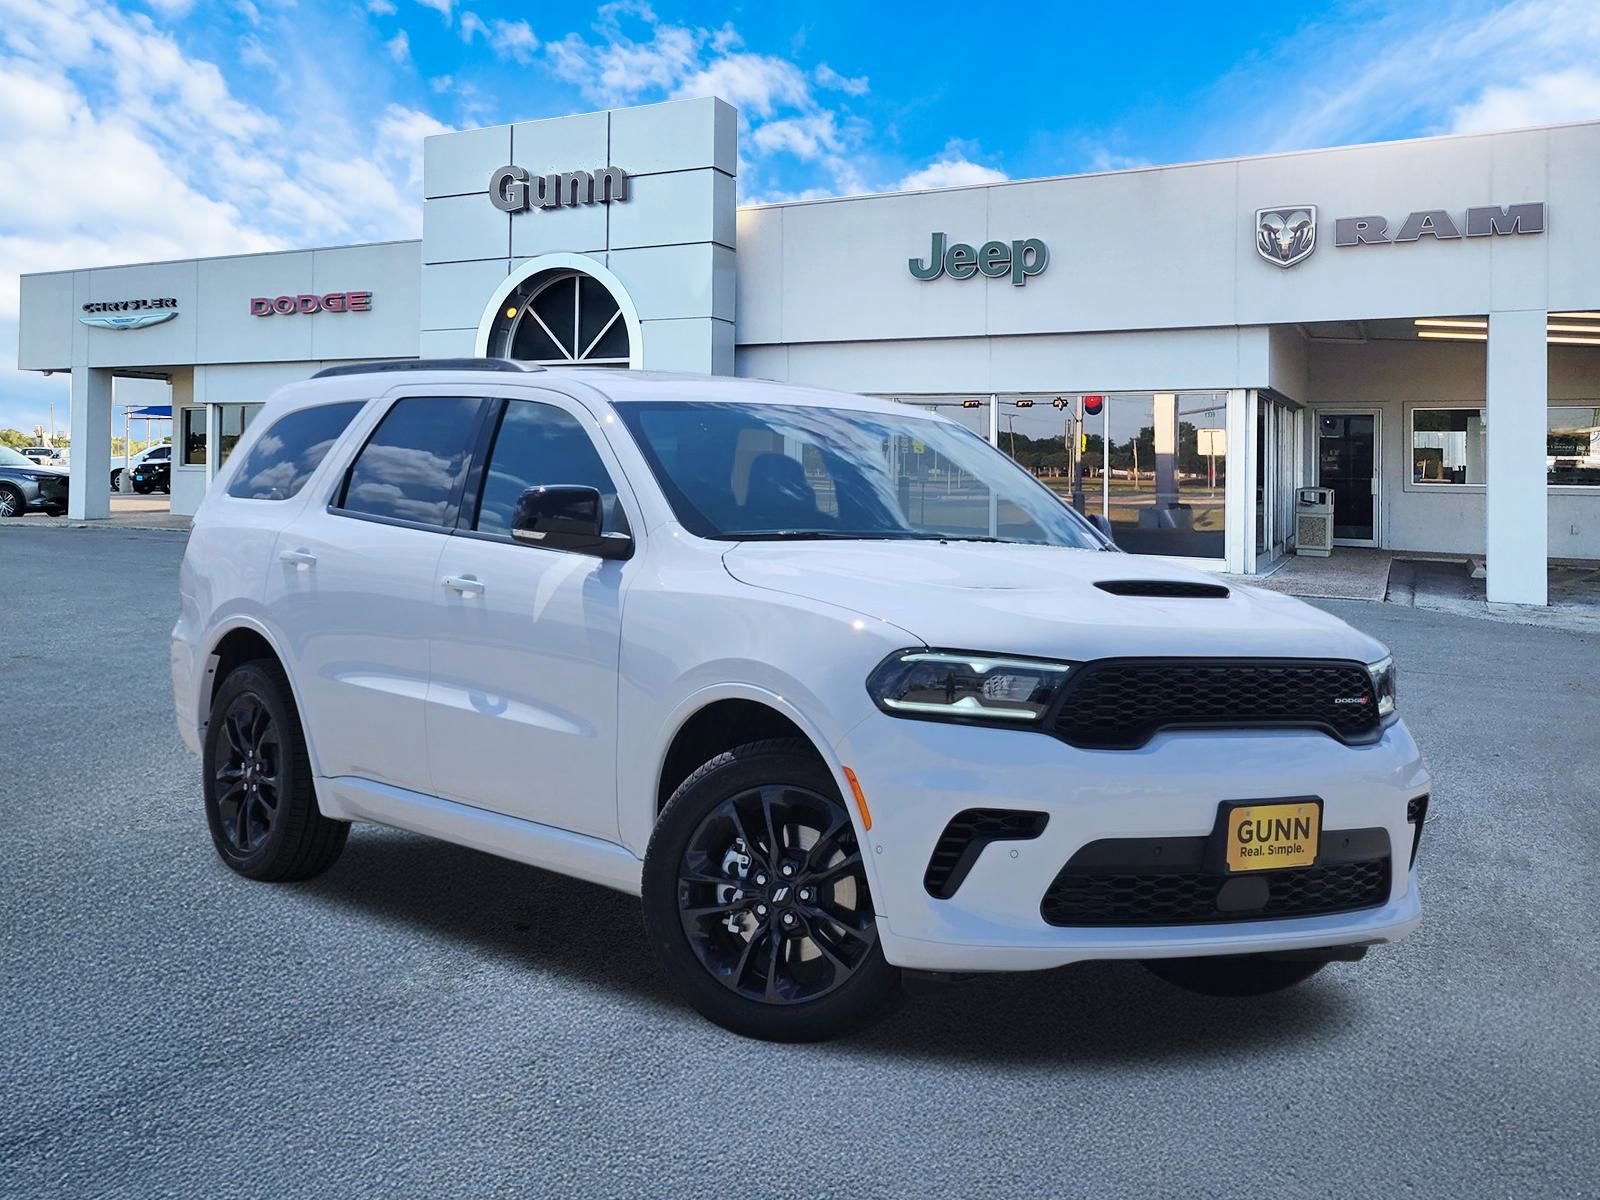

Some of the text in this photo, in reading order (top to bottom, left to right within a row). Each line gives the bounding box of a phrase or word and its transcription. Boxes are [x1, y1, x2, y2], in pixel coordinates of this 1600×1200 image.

[489, 165, 630, 213] Gunn
[1335, 202, 1546, 247] RAM
[908, 232, 1049, 286] Jeep
[82, 298, 177, 313] CHRYSLER
[250, 292, 372, 316] DODGE
[1237, 817, 1310, 844] GUNN
[1240, 843, 1305, 857] Real. Simple.
